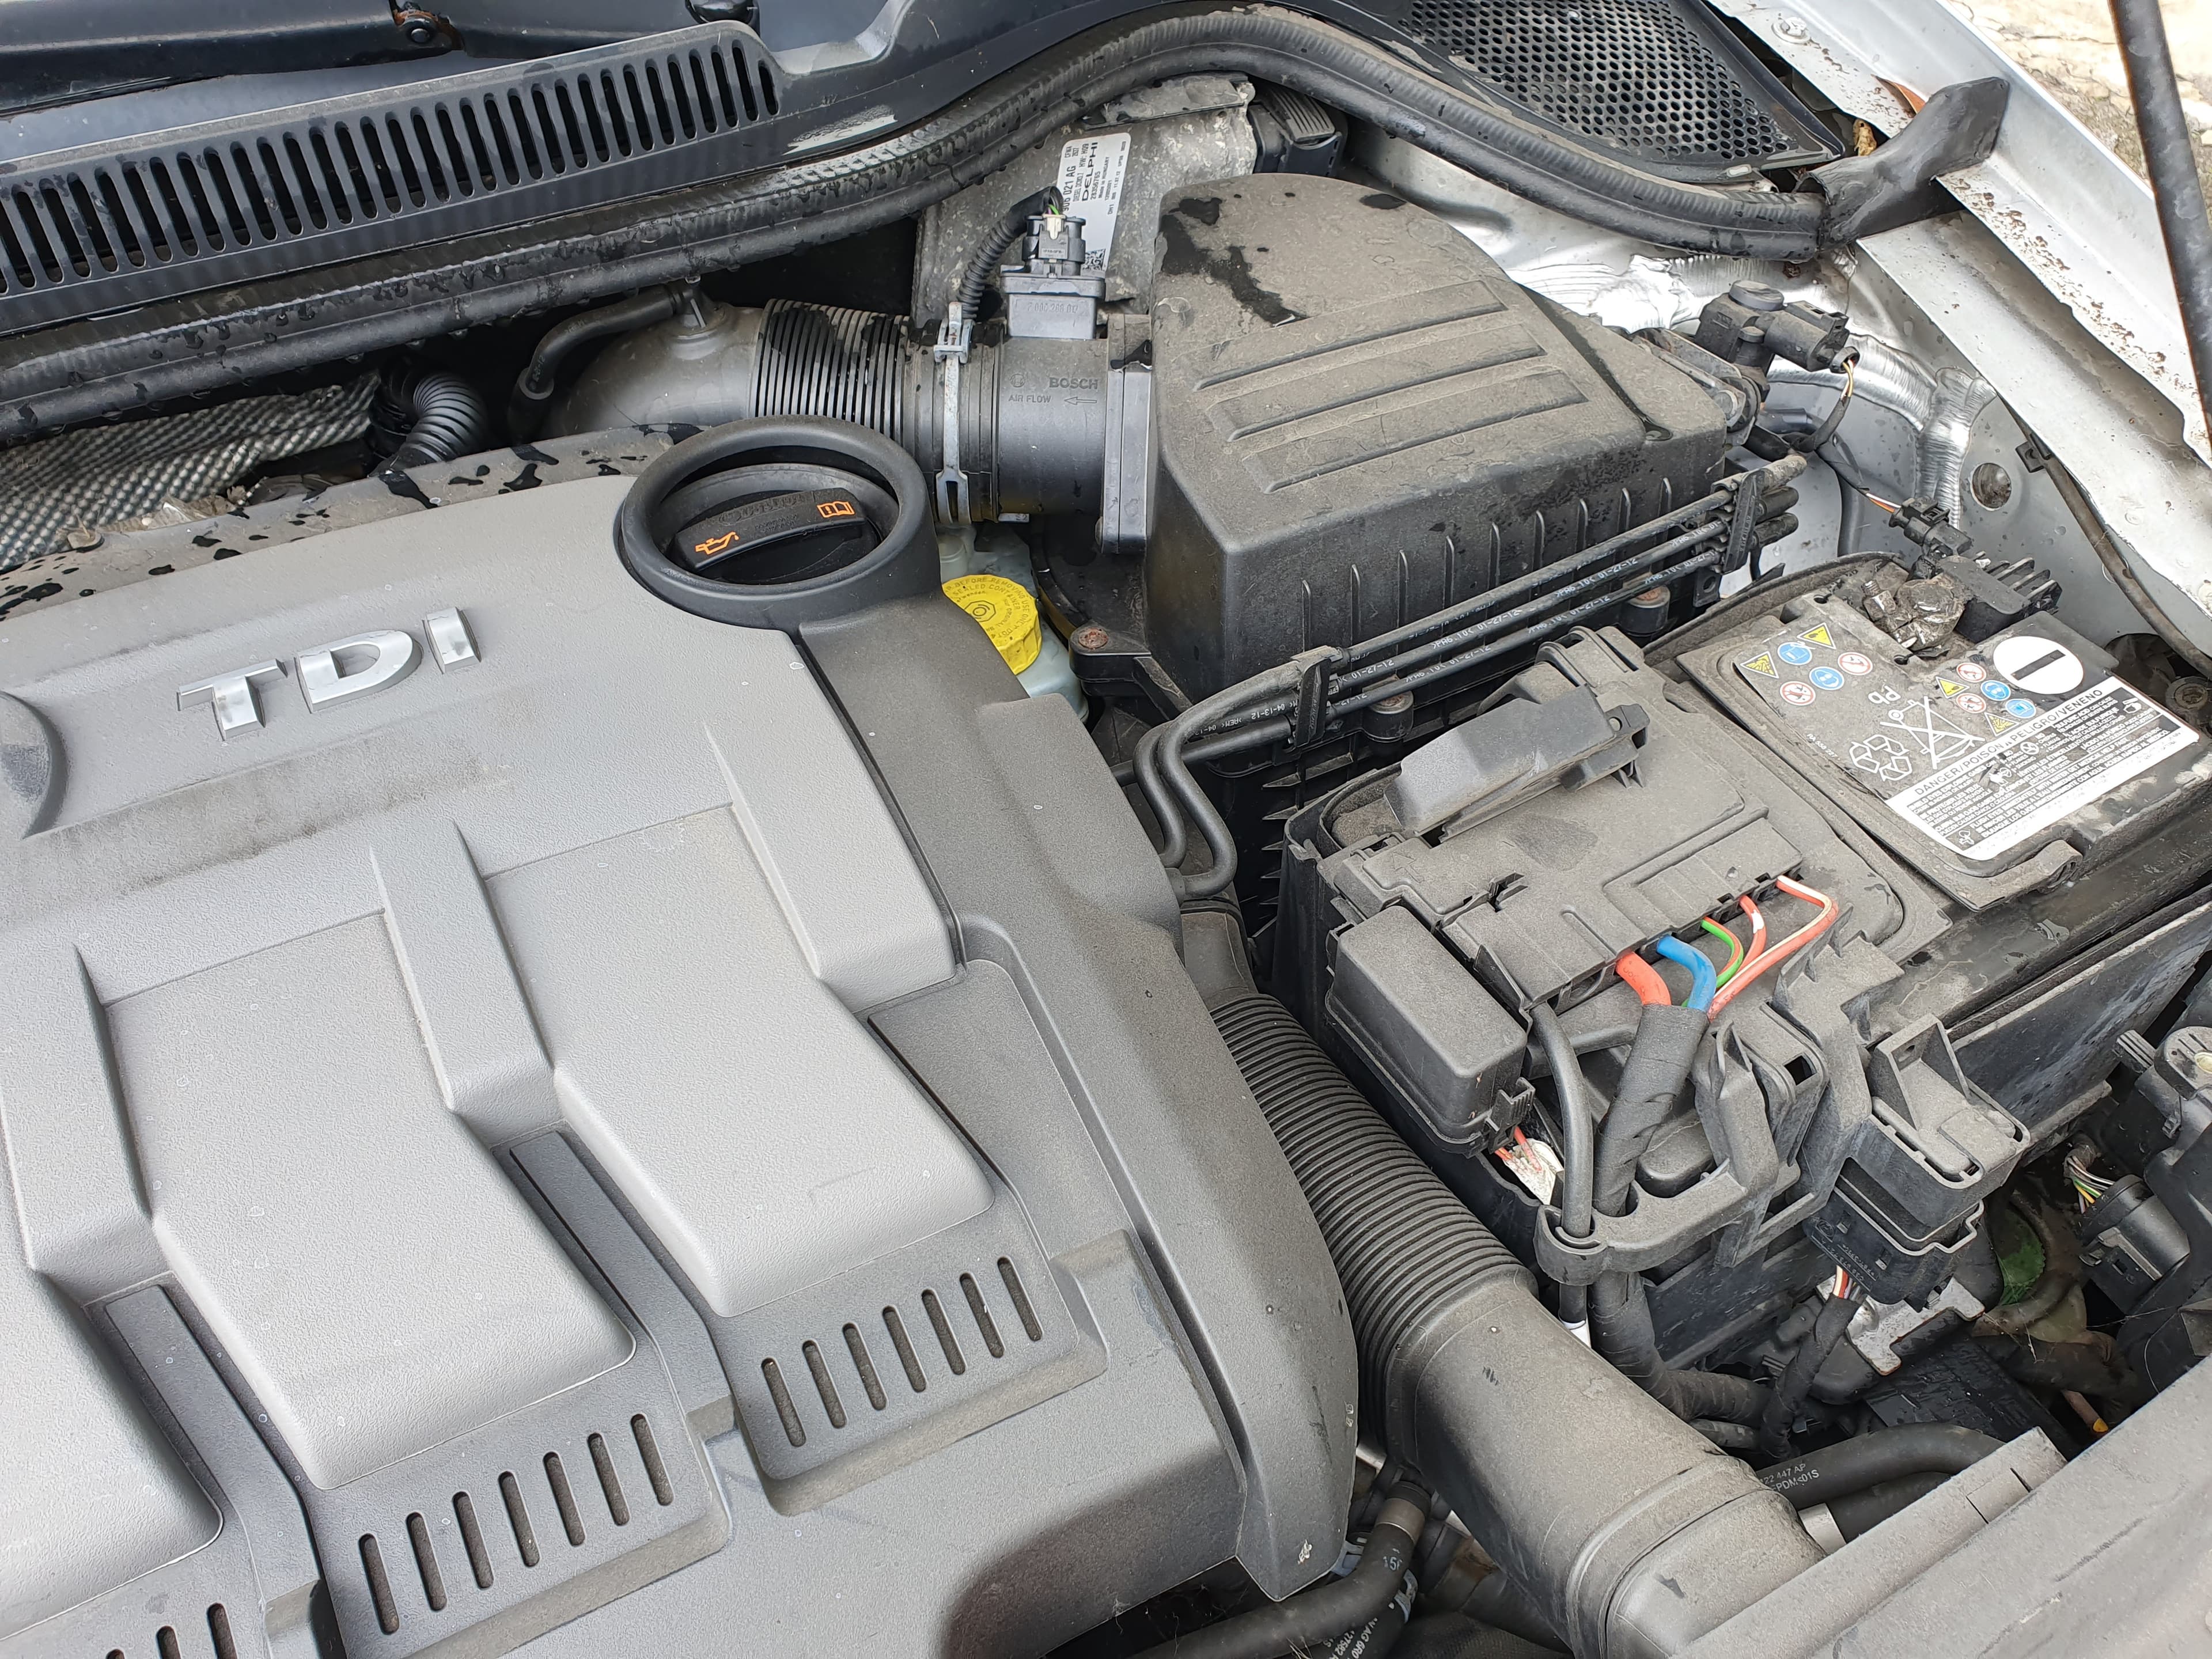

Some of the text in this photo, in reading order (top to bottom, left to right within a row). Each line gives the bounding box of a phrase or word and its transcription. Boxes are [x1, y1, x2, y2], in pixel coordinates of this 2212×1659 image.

[1066, 165, 1076, 177] AG
[1082, 142, 1098, 201] DELPHI
[1101, 156, 1109, 180] HUNGARY
[1063, 180, 1074, 195] 021
[1049, 377, 1099, 389] BOSCH
[1008, 394, 1052, 404] AIR FLOW
[954, 577, 988, 588] BEFORE
[990, 577, 1026, 599] REMOVING
[952, 584, 986, 596] SEALED
[988, 584, 1021, 611] CONTAINER
[1022, 599, 1031, 612] USE
[1013, 614, 1032, 630] ONLY
[998, 628, 1014, 638] DOT
[1351, 658, 1395, 679] 01-27-12
[1476, 608, 1520, 631] 01-27-12
[176, 606, 482, 741] TDI
[1868, 685, 1902, 705] Pb
[1251, 702, 1286, 720] 04-13-12
[1912, 688, 2104, 796] DANGER/POISON PELIGRO/VENENO
[2036, 757, 2050, 766] LES
[1925, 789, 1944, 801] EYES
[1966, 764, 1988, 778] GASES
[1984, 759, 1997, 767] CAN
[2031, 768, 2045, 777] LES
[1986, 807, 2004, 819] EYES
[2035, 780, 2053, 791] WITH
[2048, 770, 2071, 783] WATER
[2066, 764, 2082, 774] GET
[2100, 744, 2118, 755] HELP
[1953, 790, 1967, 800] LES
[1963, 783, 1982, 794] YEUX
[2007, 812, 2022, 822] LOS
[2018, 804, 2037, 816] OJOS
[2075, 773, 2092, 783] CON
[1976, 795, 1997, 808] GASES
[2002, 808, 2018, 817] LES
[2013, 800, 2032, 812] YEUX
[1794, 1463, 1806, 1474] AP
[1361, 1625, 1372, 1642] AG
